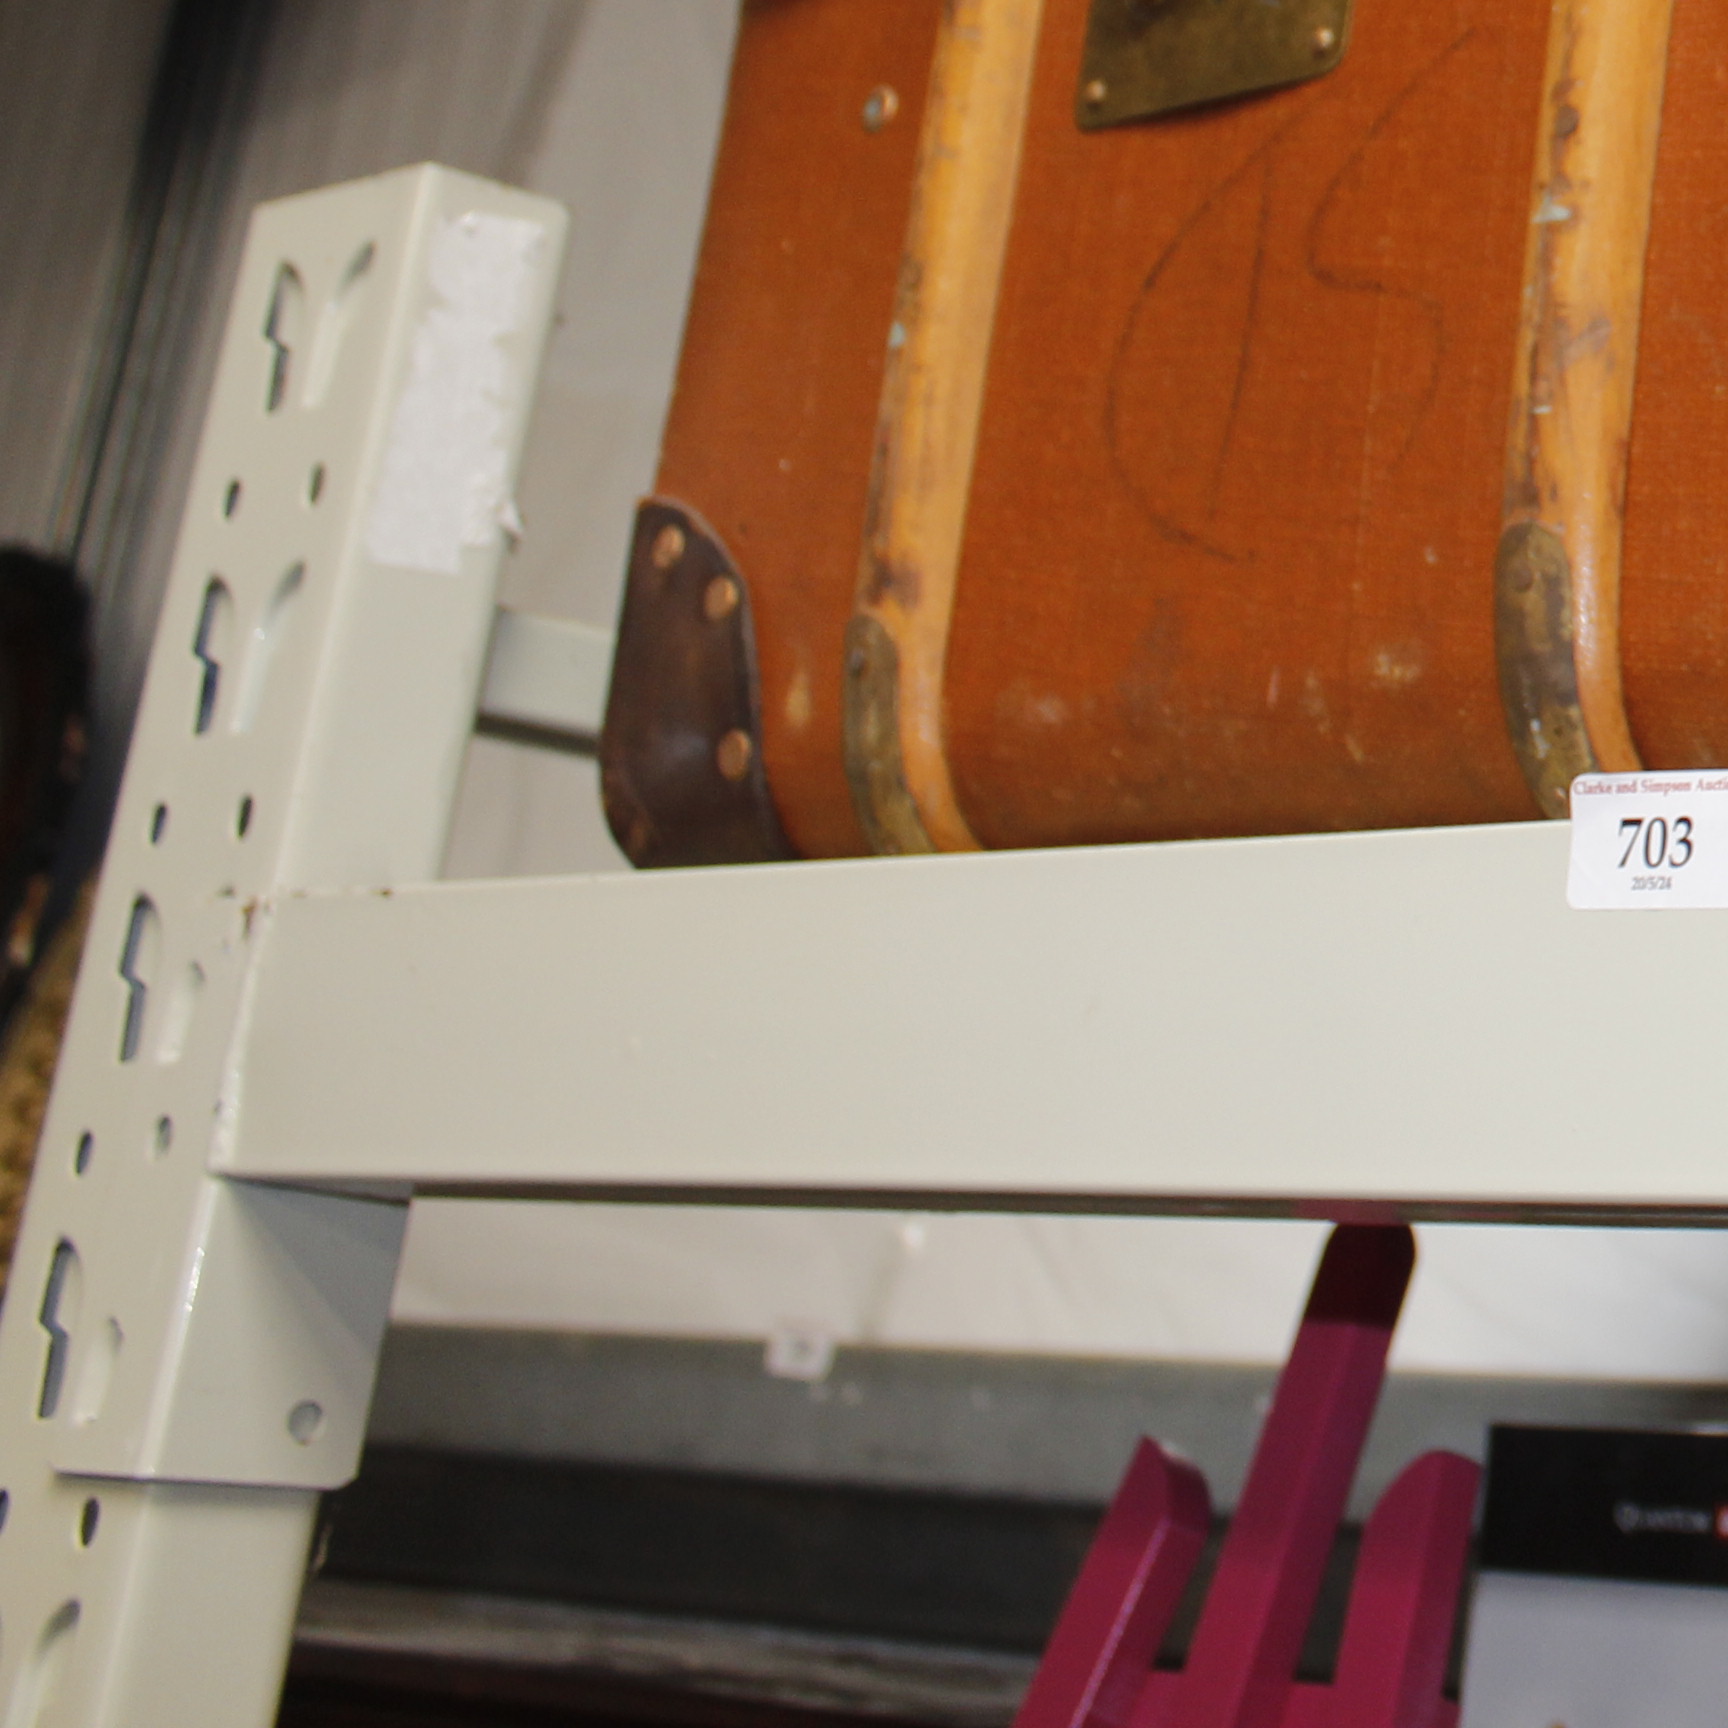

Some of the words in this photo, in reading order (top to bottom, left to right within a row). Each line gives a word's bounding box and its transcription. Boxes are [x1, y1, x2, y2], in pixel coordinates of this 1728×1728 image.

[1573, 779, 1612, 795] Clarke
[1615, 779, 1638, 794] and
[1641, 777, 1692, 797] Simpson
[1617, 815, 1694, 869] 703
